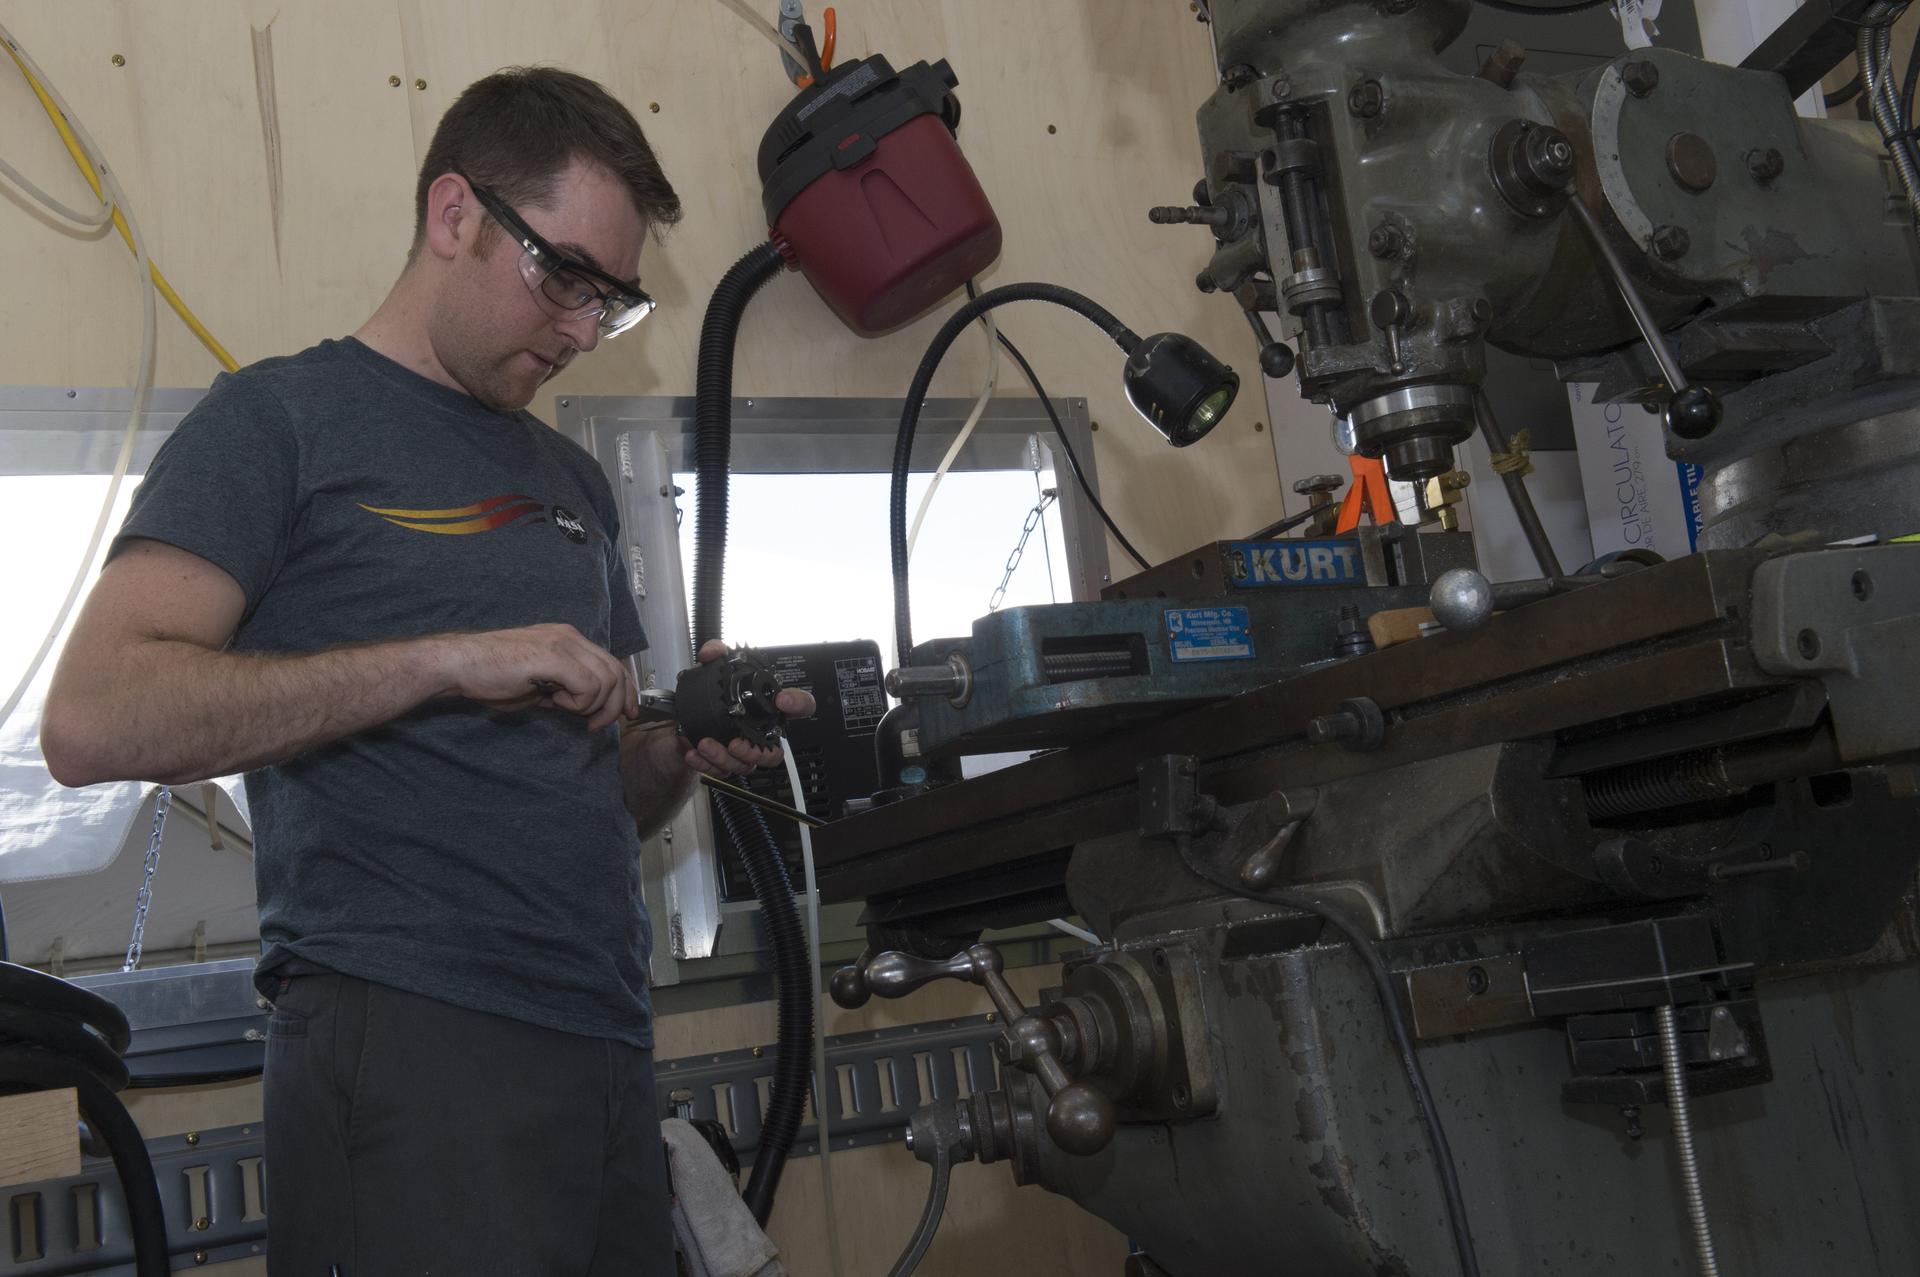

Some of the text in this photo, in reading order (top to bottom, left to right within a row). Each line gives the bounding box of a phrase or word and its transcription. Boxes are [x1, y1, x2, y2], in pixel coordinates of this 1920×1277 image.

[1604, 403, 1642, 544] CIRCULATO
[1633, 461, 1645, 484] 279
[1684, 462, 1704, 537] TABLE TIL
[556, 516, 585, 533] NASA
[1642, 517, 1651, 534] DE
[1251, 546, 1357, 582] KURT
